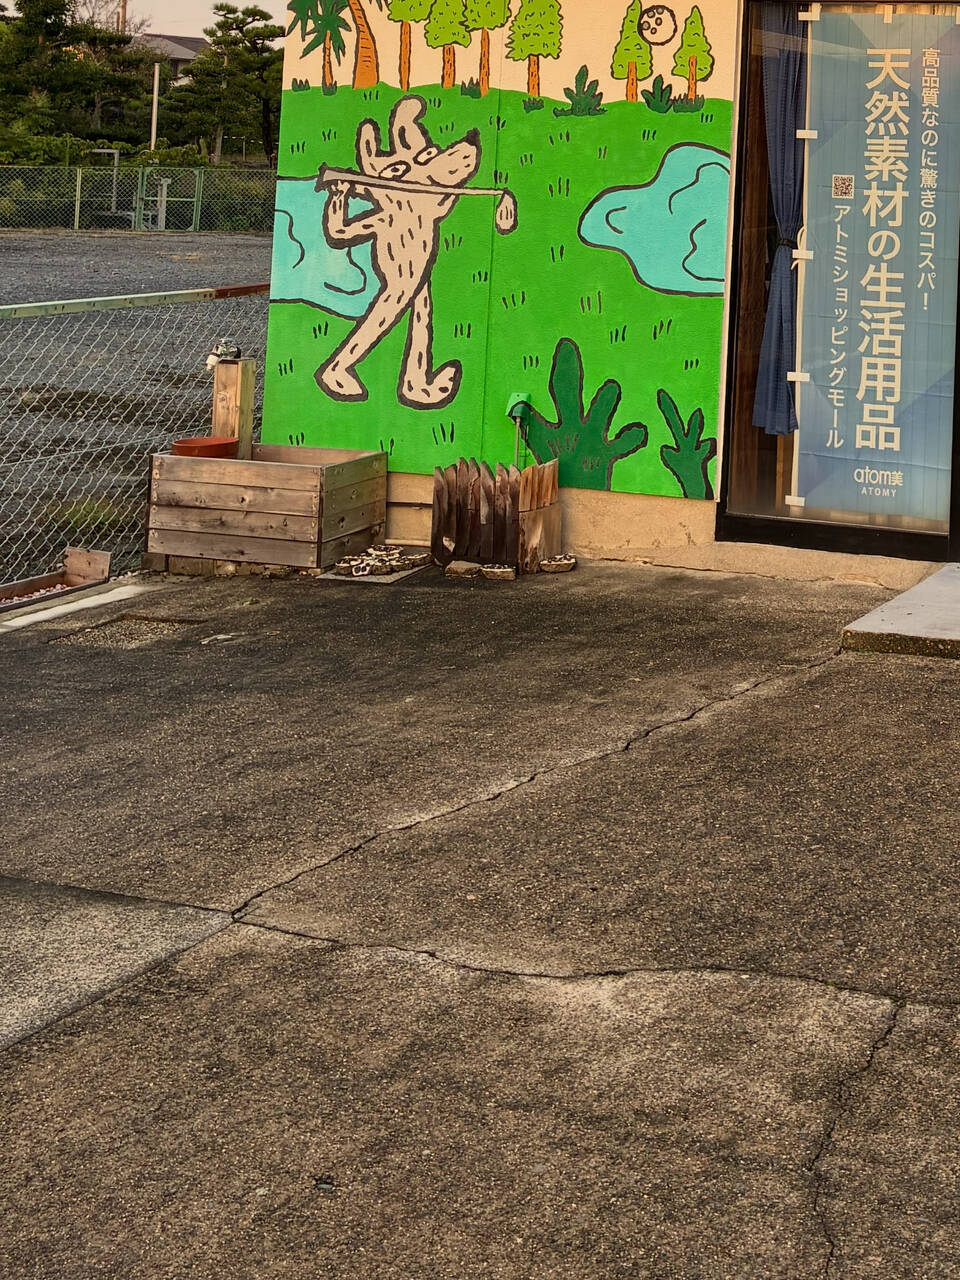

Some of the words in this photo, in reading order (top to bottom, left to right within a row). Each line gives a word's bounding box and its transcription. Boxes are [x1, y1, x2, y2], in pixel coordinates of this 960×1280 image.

[825, 204, 851, 449] アトミショッピングモール
[854, 47, 911, 452] 天然素材の生活用品
[861, 486, 897, 497] ATOMY
